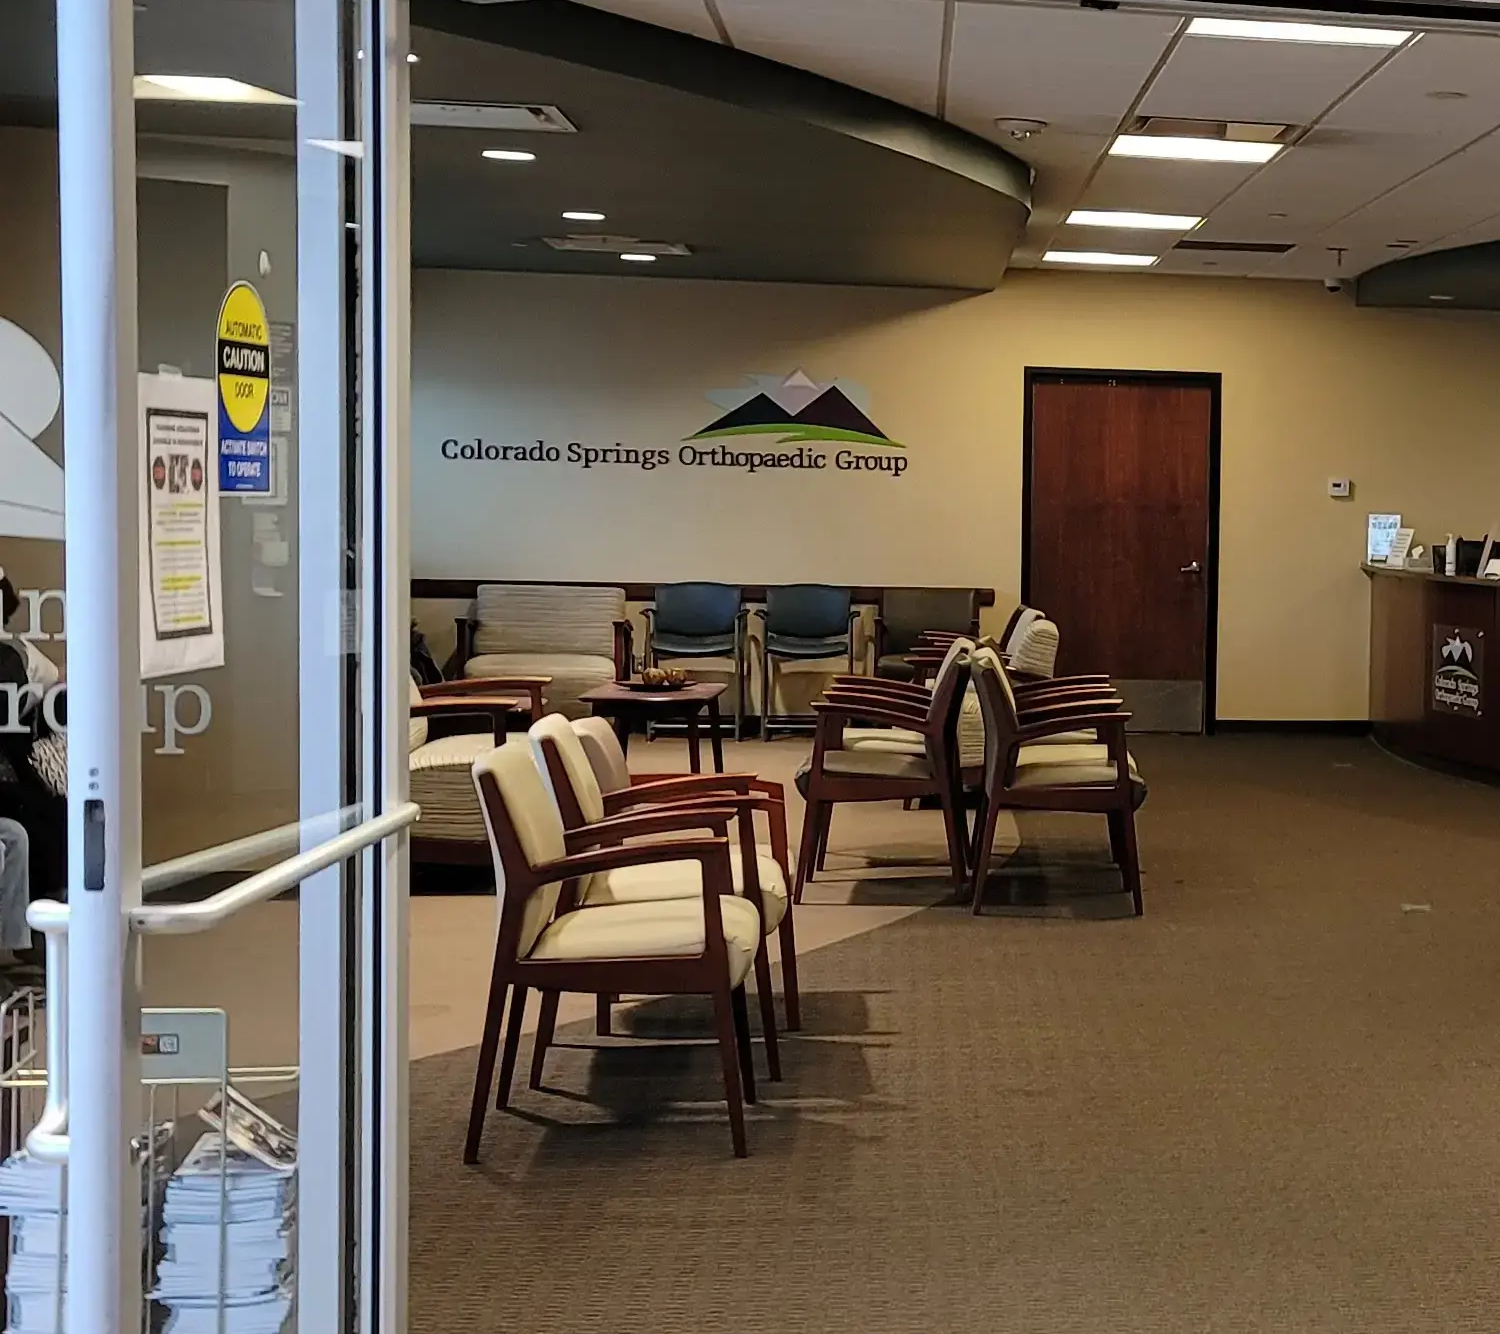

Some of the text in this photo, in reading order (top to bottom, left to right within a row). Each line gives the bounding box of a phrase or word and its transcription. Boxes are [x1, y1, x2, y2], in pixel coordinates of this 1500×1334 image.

[225, 319, 263, 340] AUTOMATIC
[223, 345, 265, 373] CAUTION
[234, 381, 254, 398] DOOR
[441, 438, 909, 476] Colorado Springs Orthopaedic Group
[228, 460, 236, 477] TO
